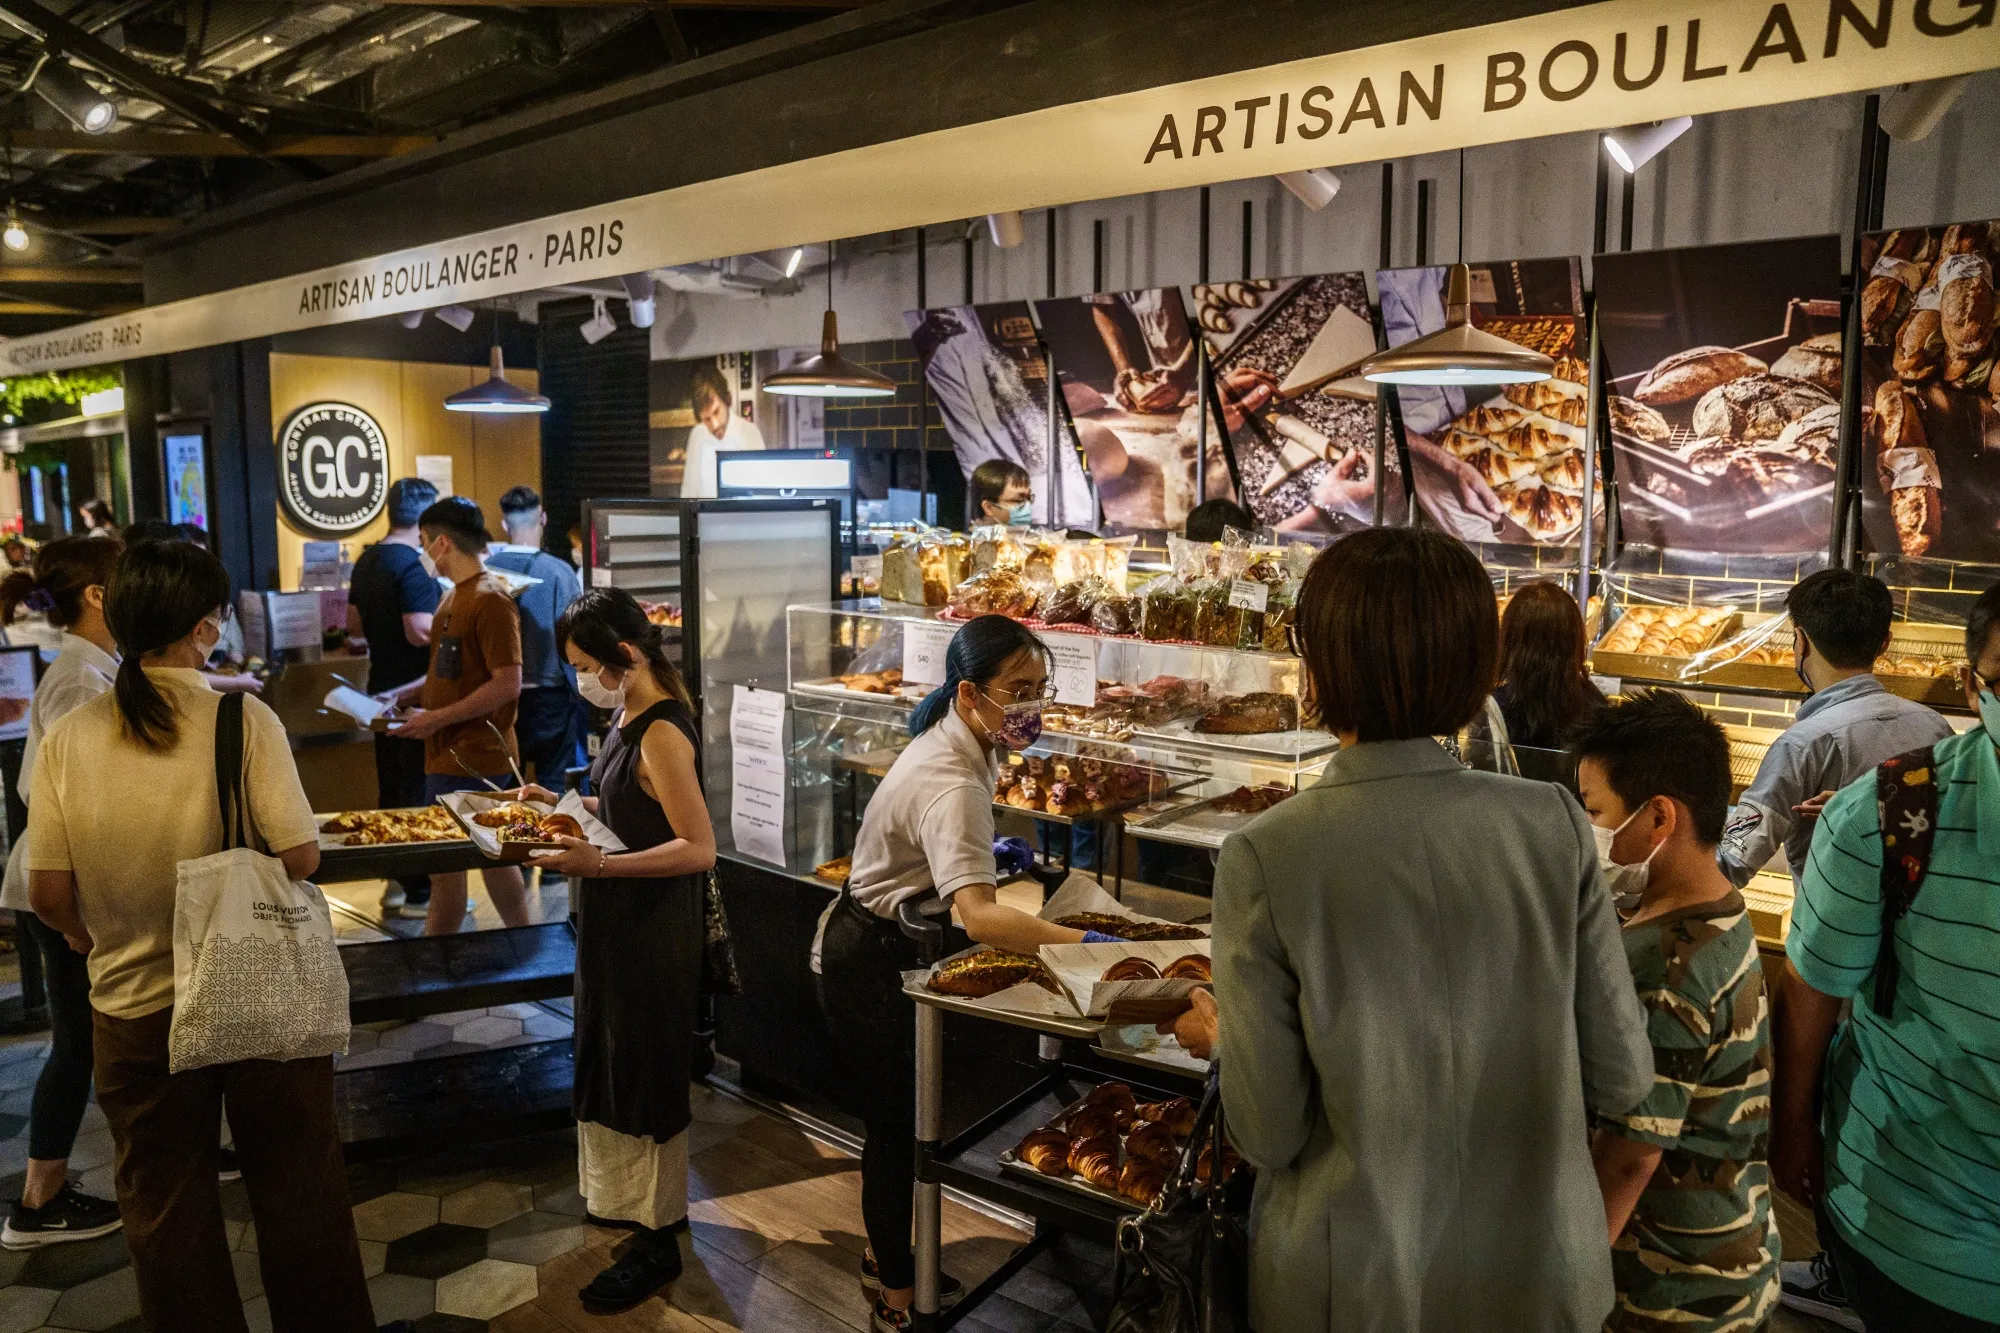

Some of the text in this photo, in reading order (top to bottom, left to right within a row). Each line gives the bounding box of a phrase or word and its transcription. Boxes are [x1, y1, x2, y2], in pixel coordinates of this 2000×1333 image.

[1144, 65, 1445, 165] ARTISAN
[299, 219, 624, 315] ARTISAN BOULANGER PARIS
[112, 322, 142, 349] PARIS
[253, 902, 279, 913] LOUIS
